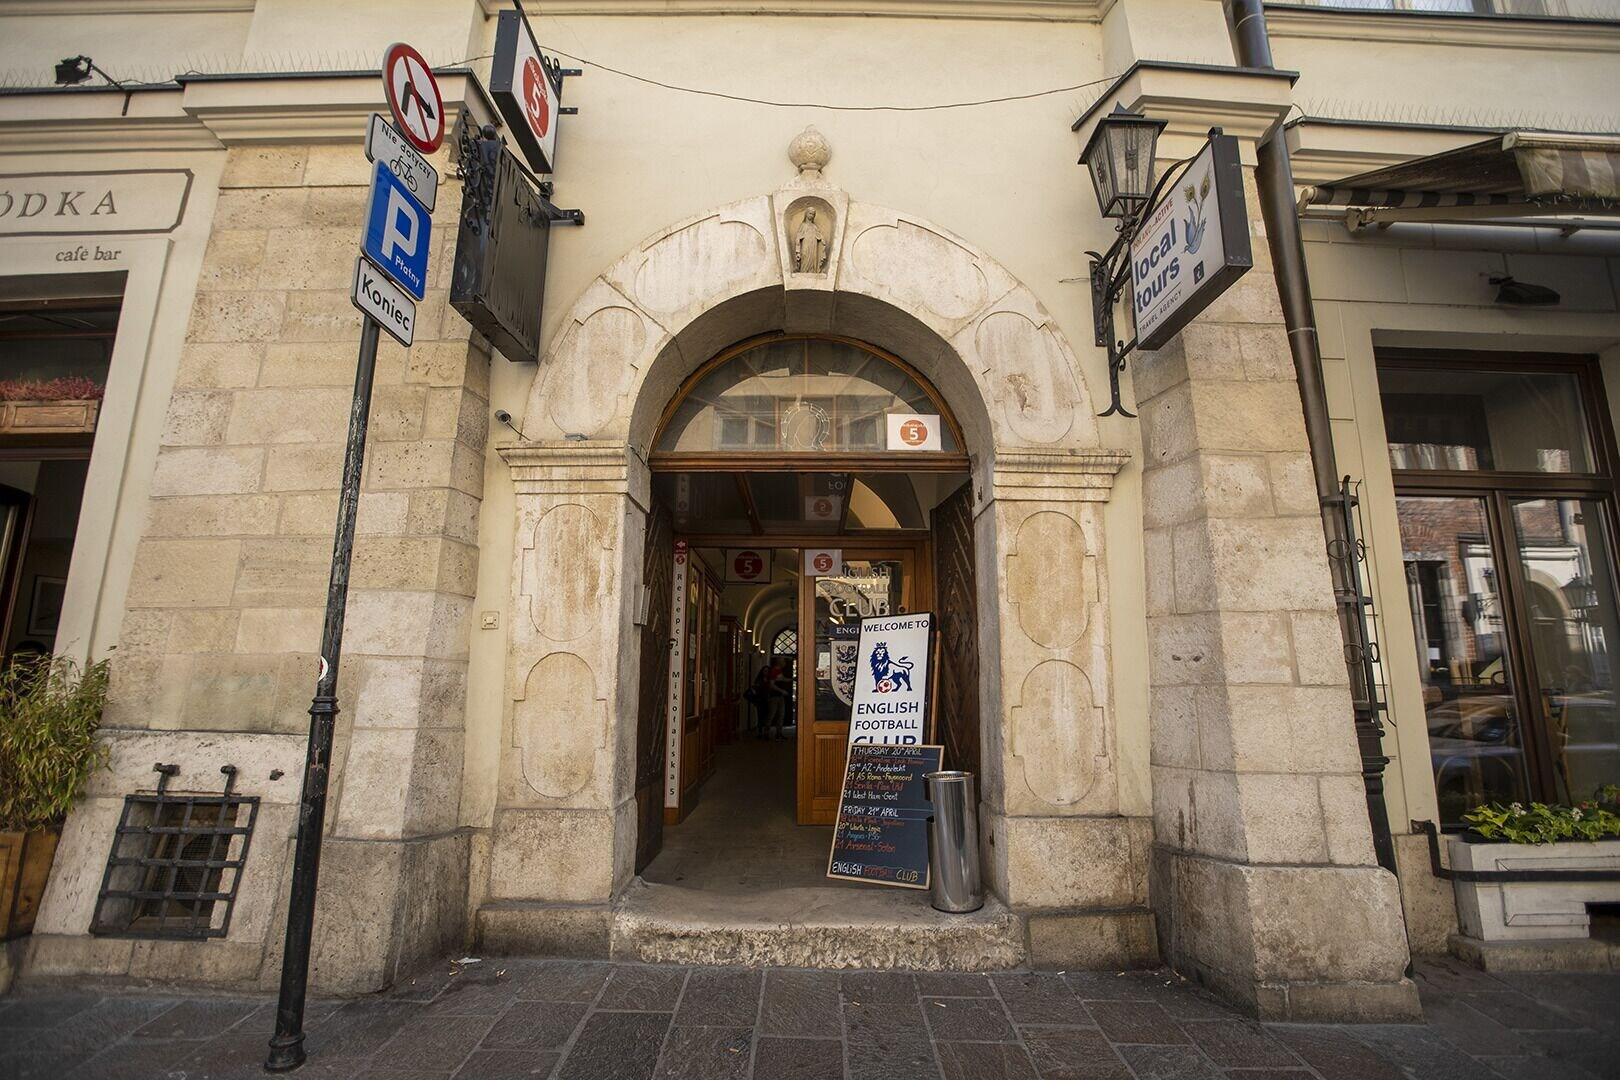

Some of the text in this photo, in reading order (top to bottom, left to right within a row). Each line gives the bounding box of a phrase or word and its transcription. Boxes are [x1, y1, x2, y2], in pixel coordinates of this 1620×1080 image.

[530, 82, 541, 118] 5
[381, 123, 431, 179] Nie dotyczy
[381, 184, 419, 260] P
[94, 246, 122, 261] bar
[1134, 218, 1176, 286] local
[395, 255, 420, 287] Płatny
[1136, 257, 1180, 313] tours
[362, 273, 410, 331] Koniec
[1140, 289, 1182, 334] TRAVEL AGENCY
[909, 427, 919, 440] 5
[743, 560, 753, 573] 5
[819, 559, 827, 569] 5
[841, 566, 889, 578] NGLISH
[829, 598, 889, 617] CLUB
[864, 619, 929, 633] WELCOME TO
[857, 701, 919, 715] ENGLISH
[855, 719, 918, 731] FOOTBALL
[853, 746, 889, 756] THURSDAY
[896, 869, 919, 882] CLUB
